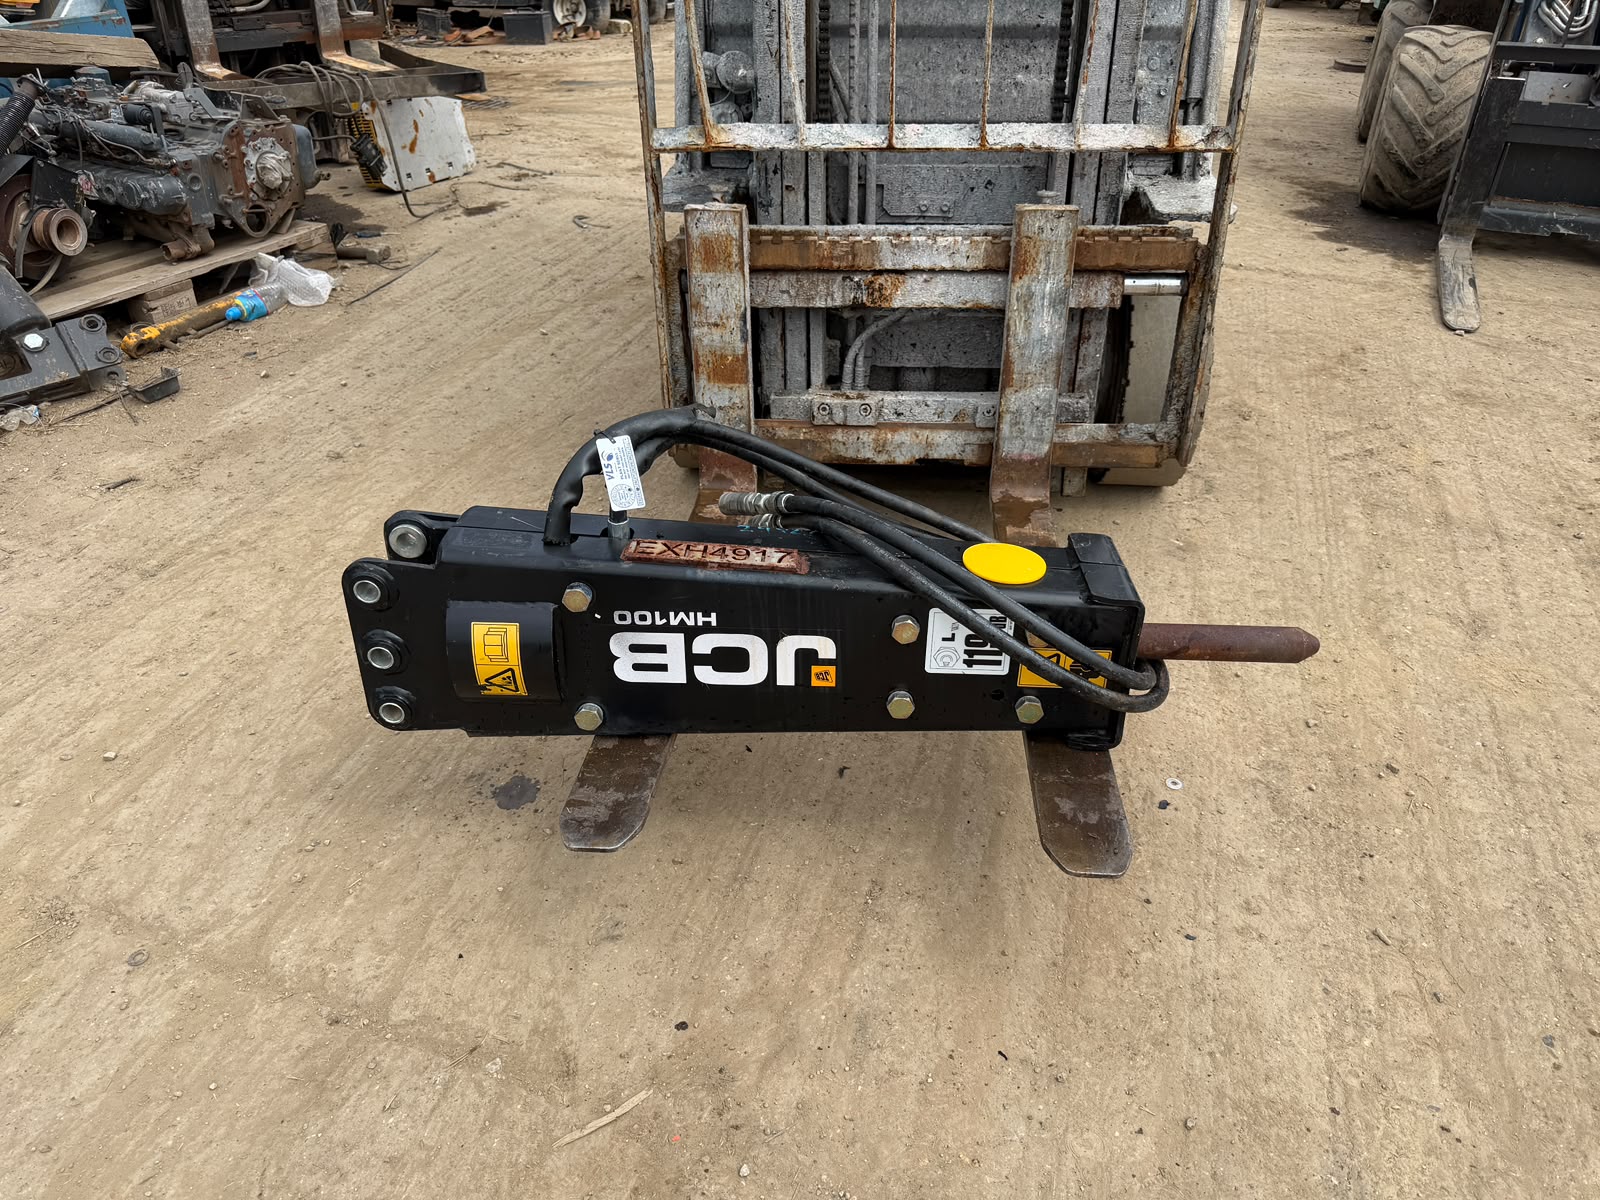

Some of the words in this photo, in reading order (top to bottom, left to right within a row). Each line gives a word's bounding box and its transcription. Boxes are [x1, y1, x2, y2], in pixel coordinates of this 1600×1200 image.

[604, 463, 614, 480] VLS
[635, 540, 792, 564] EXH4917
[613, 610, 717, 626] HM100
[609, 632, 837, 686] JCB
[814, 670, 831, 682] JCB
